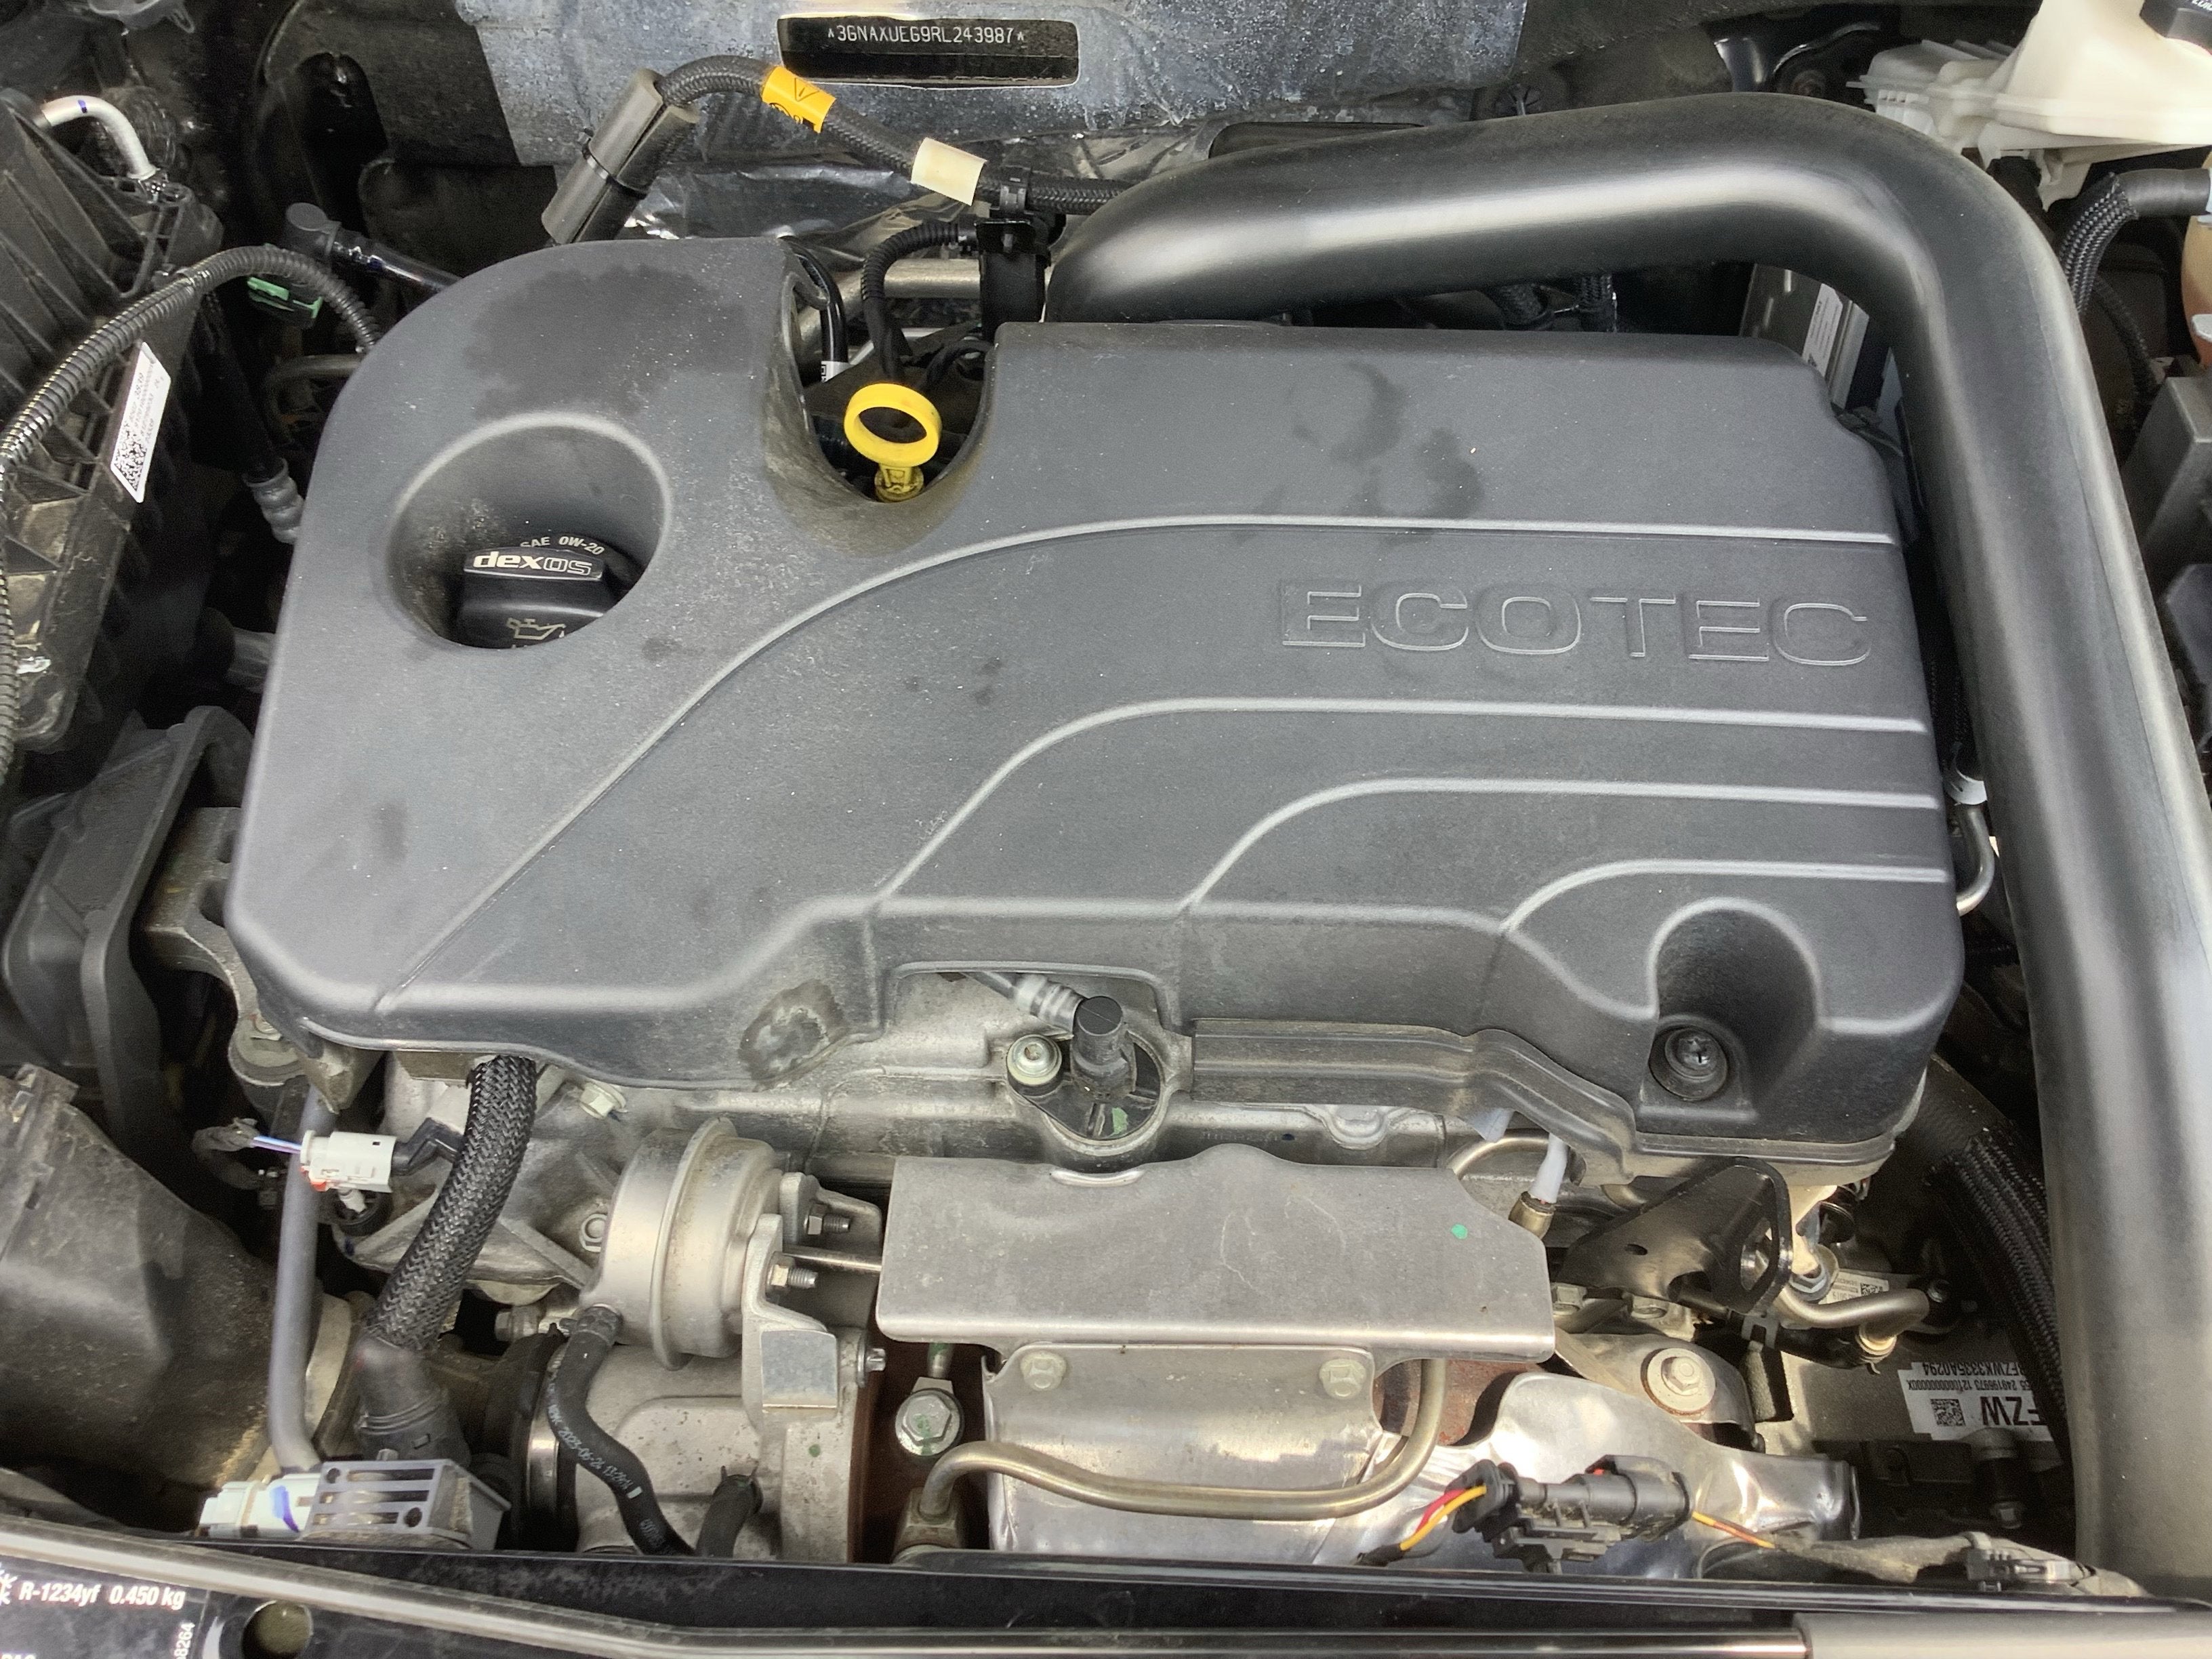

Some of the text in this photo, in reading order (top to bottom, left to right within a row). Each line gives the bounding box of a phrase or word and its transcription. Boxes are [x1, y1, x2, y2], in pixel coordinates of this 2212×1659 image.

[558, 536, 605, 556] 0W-20
[473, 551, 593, 575] dexos
[1280, 582, 1872, 666] ECOTEC
[18, 1581, 186, 1611] R-1234yf 0.450 kg
[173, 1622, 196, 1659] 8264
